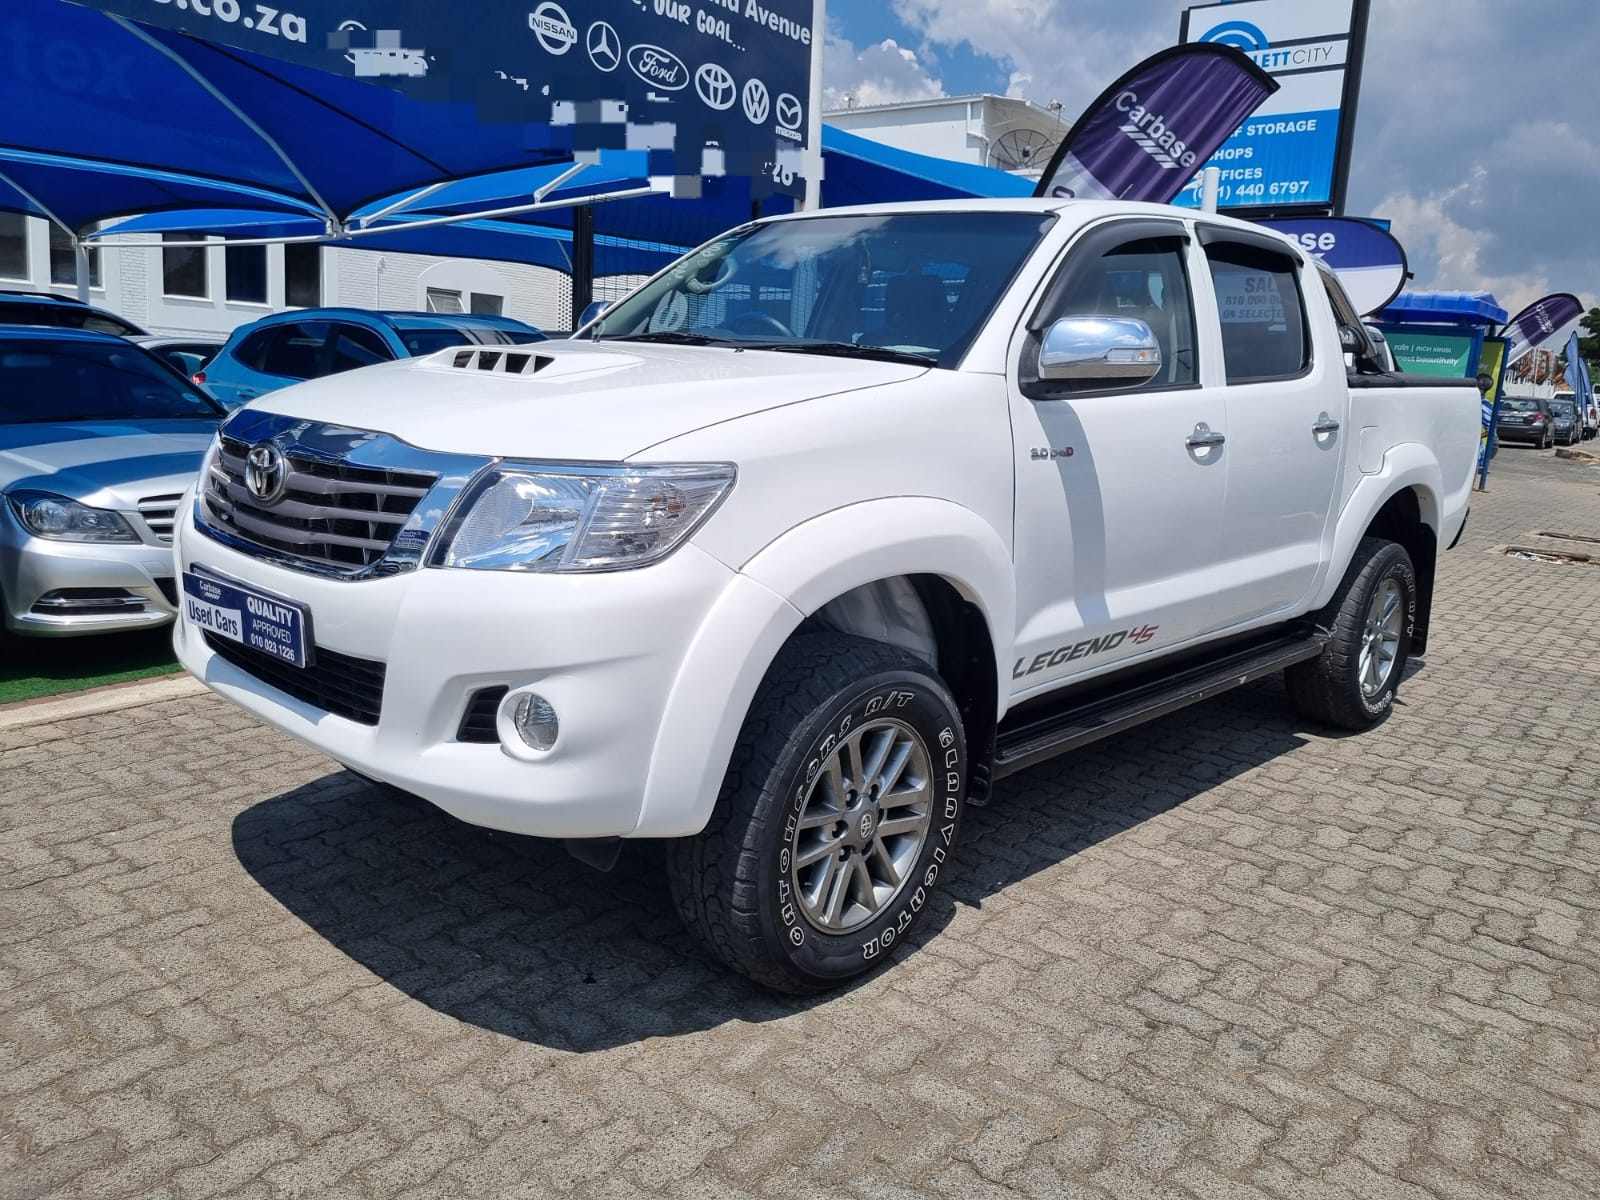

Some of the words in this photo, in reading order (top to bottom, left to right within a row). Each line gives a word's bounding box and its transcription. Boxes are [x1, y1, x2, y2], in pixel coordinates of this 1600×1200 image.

[531, 17, 576, 40] NISSAN
[745, 0, 811, 45] Avenue
[639, 50, 679, 83] Ford
[1116, 91, 1196, 167] Carbase
[1246, 120, 1317, 136] STORAGE
[1209, 147, 1253, 160] HOPS
[1218, 167, 1263, 181] FICES
[1235, 183, 1264, 197] 440
[1269, 180, 1310, 195] 6797
[188, 599, 212, 626] Used
[215, 609, 238, 637] Cars
[247, 596, 293, 628] QUALITY
[253, 618, 292, 644] APPROVED
[251, 632, 264, 648] 010
[265, 638, 278, 654] 023
[279, 644, 295, 661] 1226
[864, 690, 915, 717] A/T
